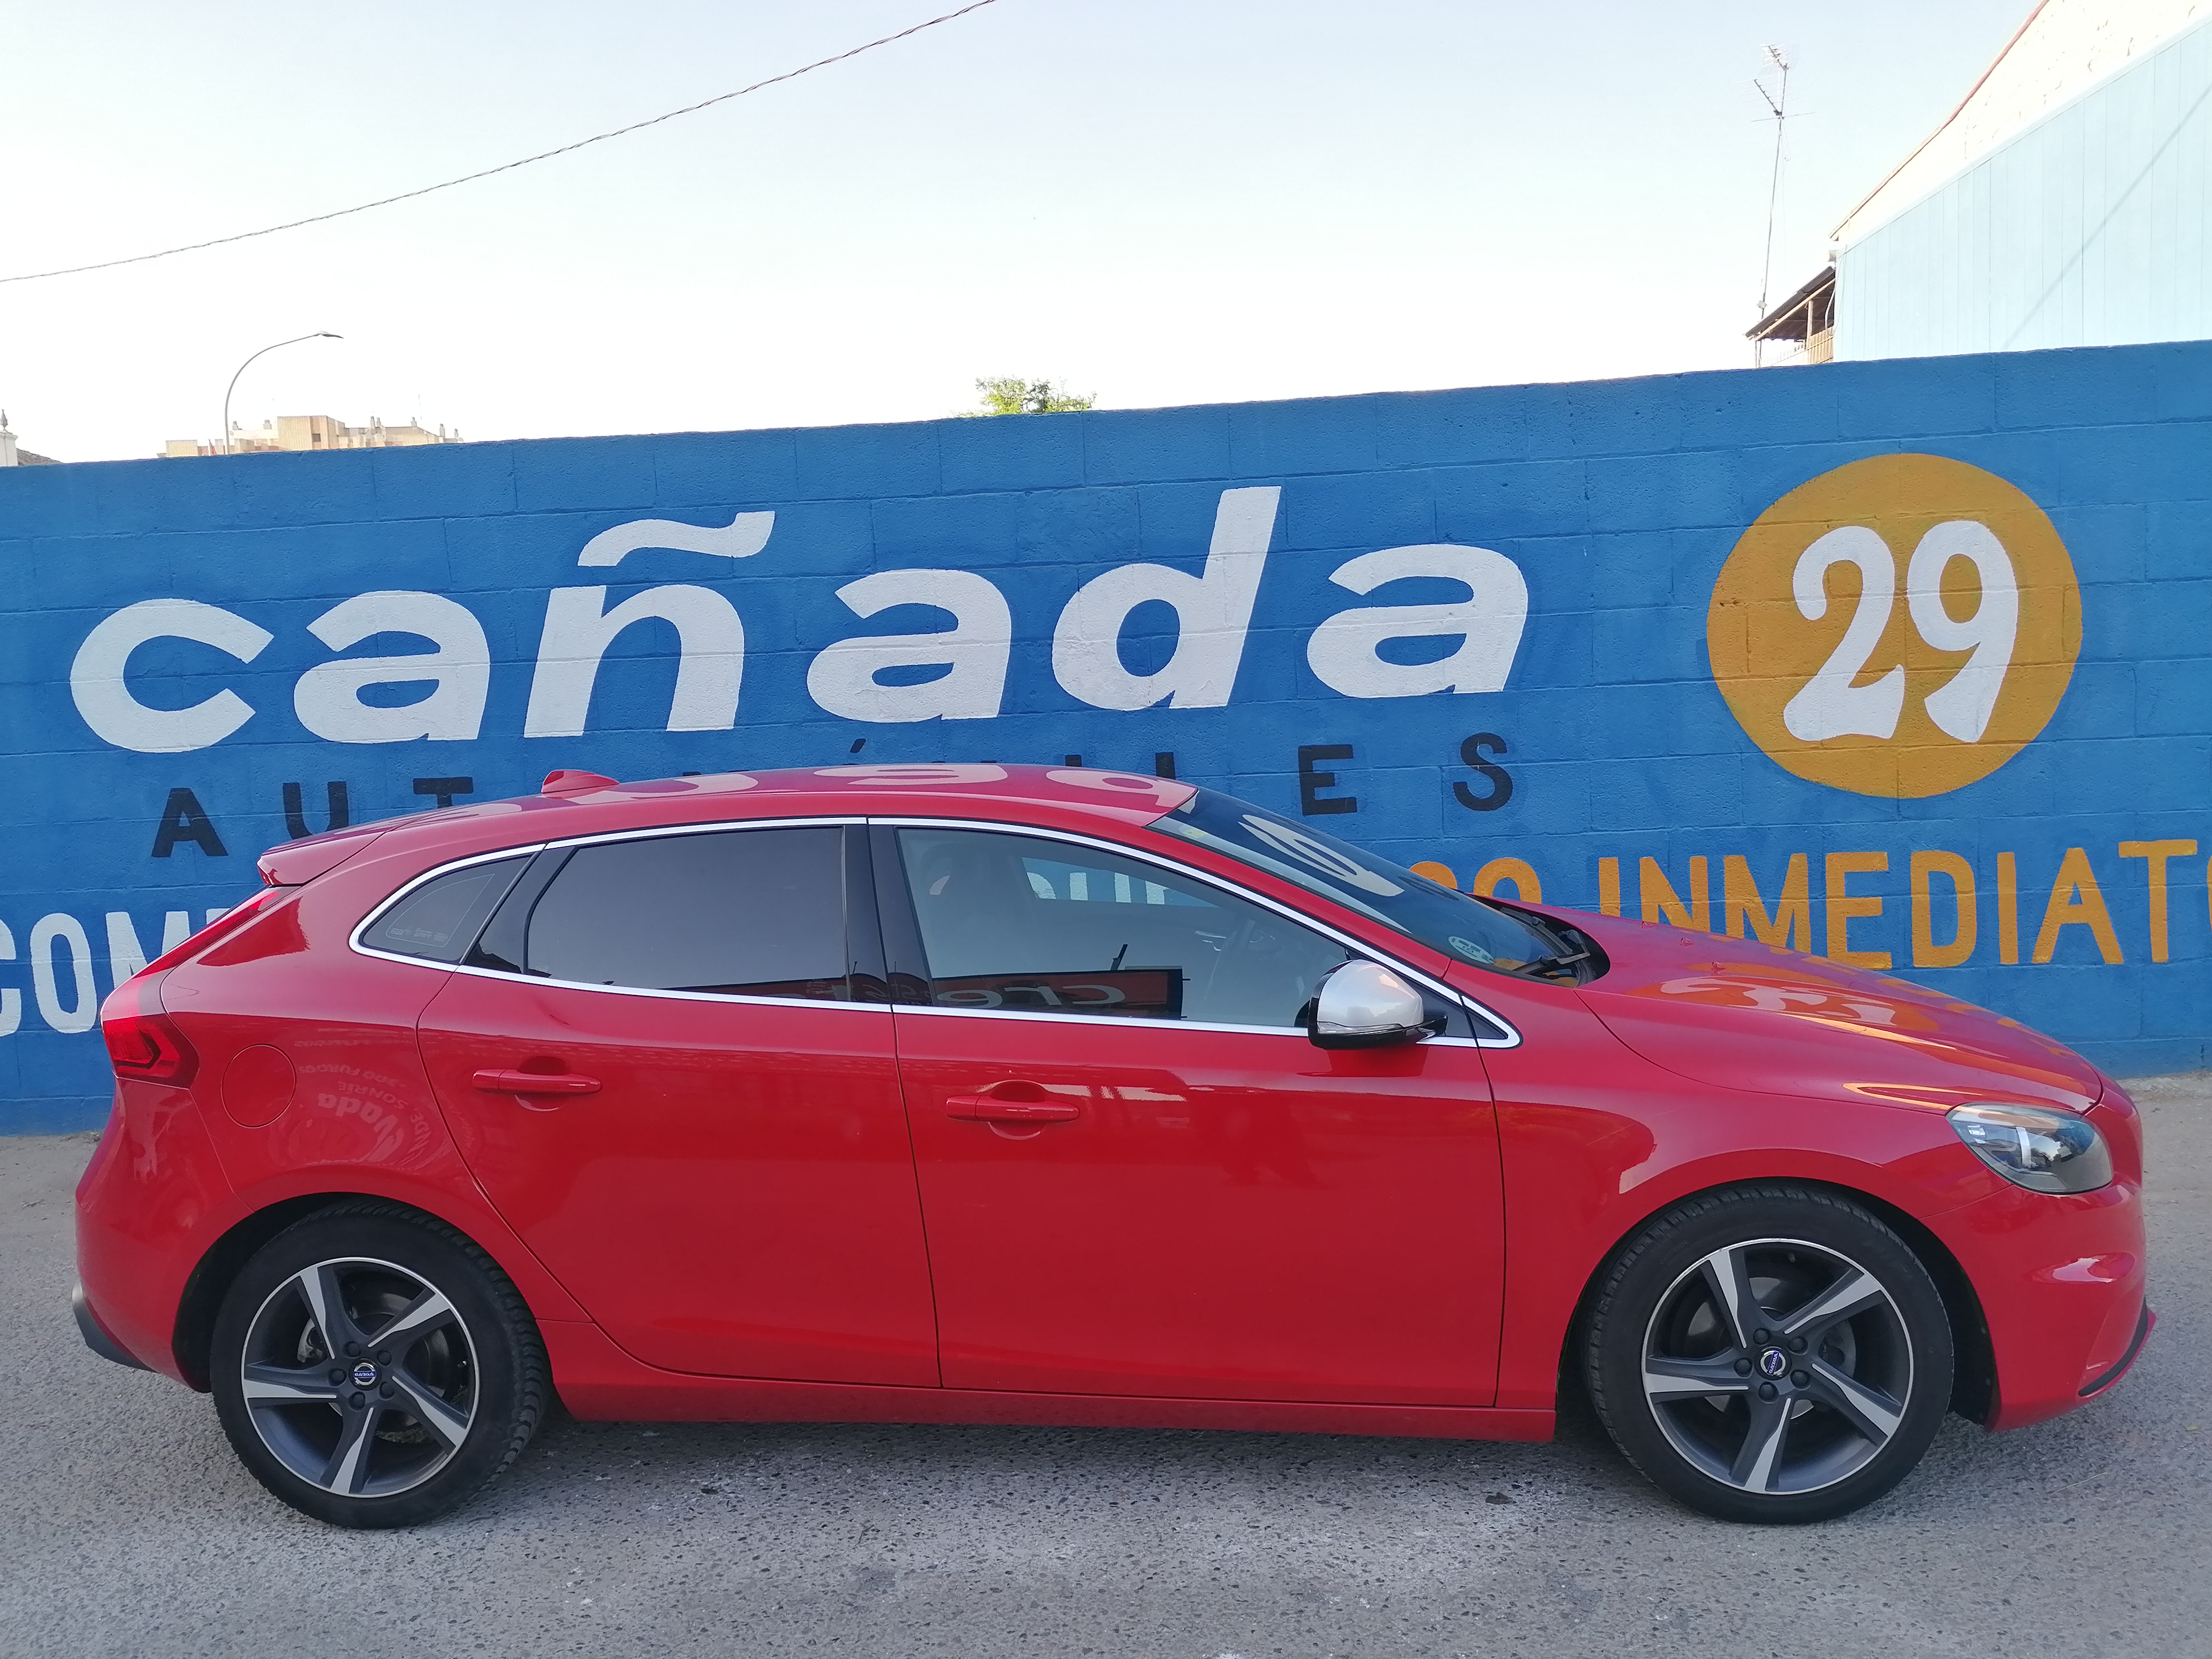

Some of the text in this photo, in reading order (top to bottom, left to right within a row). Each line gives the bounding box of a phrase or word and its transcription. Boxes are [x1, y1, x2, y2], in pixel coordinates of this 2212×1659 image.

[70, 486, 1528, 753] cañada
[1783, 520, 2018, 742] 29
[1599, 839, 2212, 970] INMEDIAT
